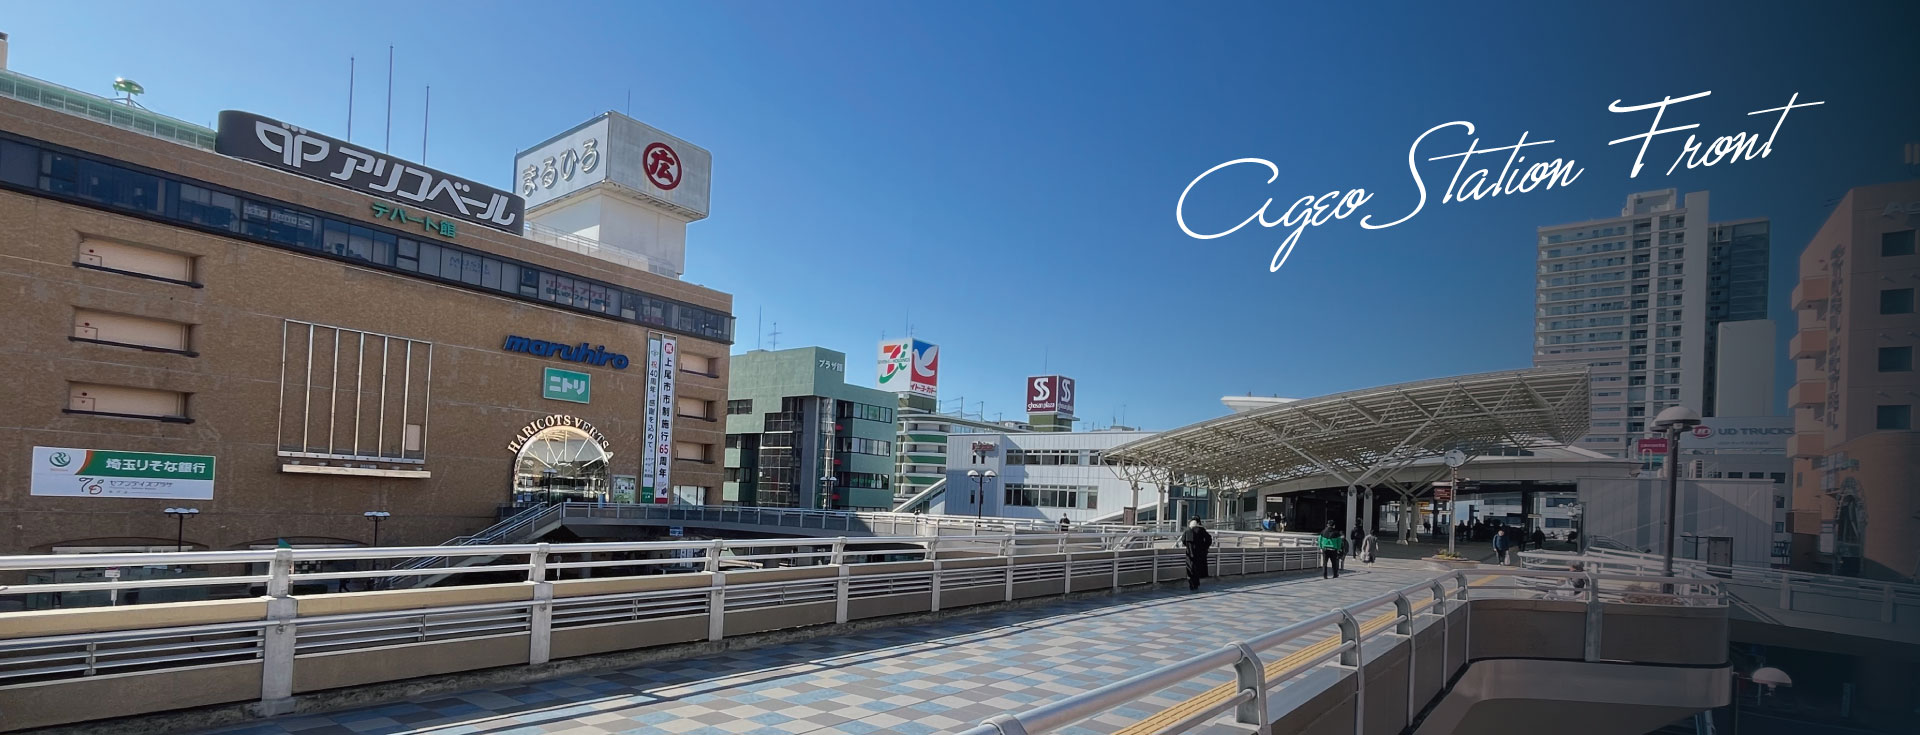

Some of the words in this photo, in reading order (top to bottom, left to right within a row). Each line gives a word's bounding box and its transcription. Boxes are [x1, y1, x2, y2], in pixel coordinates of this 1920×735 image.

[522, 138, 599, 196] まるひろ
[647, 147, 677, 186] 広
[330, 147, 515, 226] アリコベール
[505, 335, 629, 369] maruhiro
[549, 375, 586, 395] ニトリ
[105, 458, 206, 474] 埼玉りそな銀行
